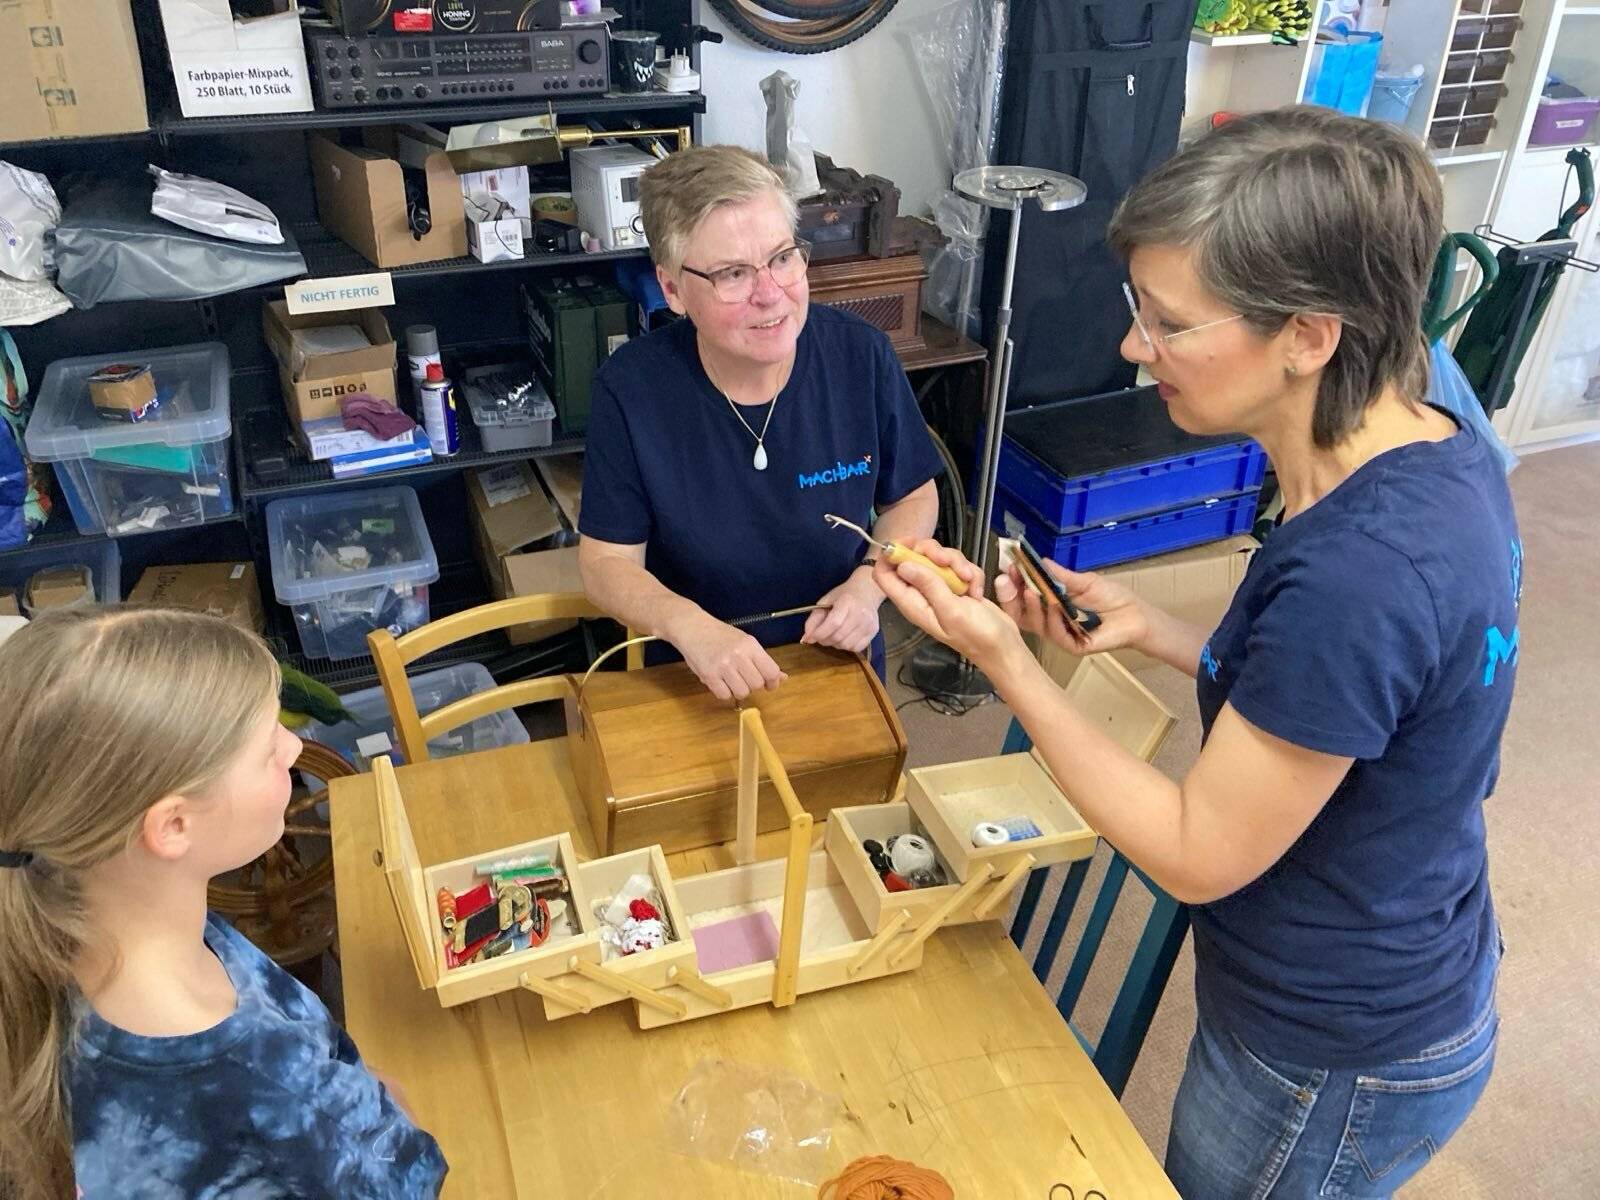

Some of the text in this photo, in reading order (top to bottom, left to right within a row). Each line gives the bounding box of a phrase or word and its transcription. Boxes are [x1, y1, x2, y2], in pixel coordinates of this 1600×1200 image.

[187, 67, 293, 82] Farbpapier-Mixpack,
[196, 83, 292, 98] 250 Blatt, 10 Stück
[300, 286, 380, 303] NICHT FERTIG
